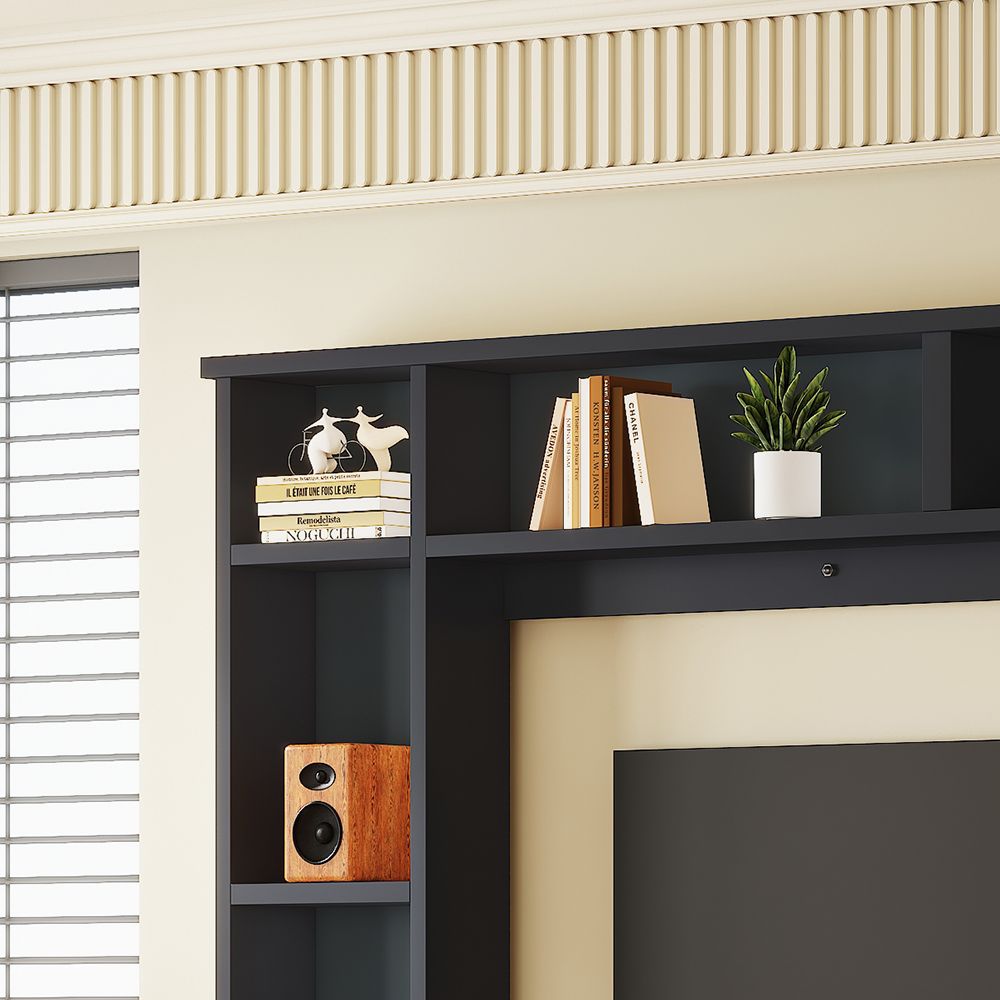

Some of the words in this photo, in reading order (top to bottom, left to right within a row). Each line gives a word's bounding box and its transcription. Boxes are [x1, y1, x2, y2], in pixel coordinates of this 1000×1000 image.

[592, 401, 600, 445] KONSTEN
[629, 402, 639, 444] CHANEL
[546, 424, 558, 458] AVEDON
[286, 488, 291, 498] IL
[292, 486, 308, 498] ÉTAIT
[308, 487, 320, 497] UNE
[320, 486, 334, 496] FOIS
[334, 485, 341, 495] LE
[341, 484, 357, 495] CAFÉ
[297, 515, 341, 525] Remodelista
[286, 528, 355, 542] NOGUCHI
